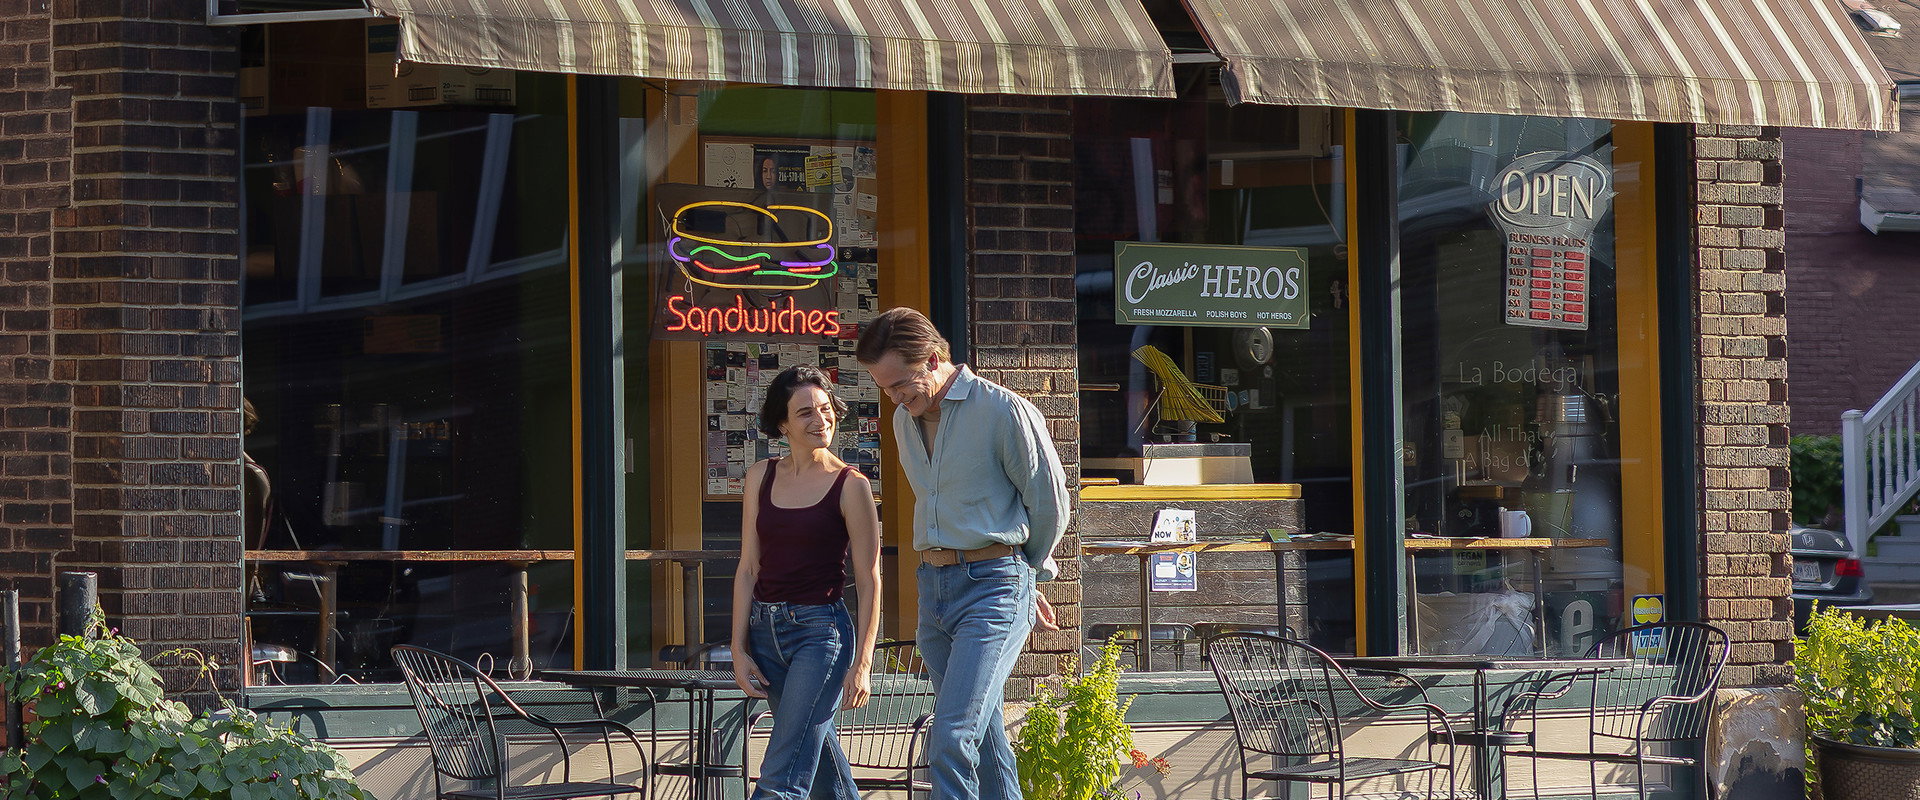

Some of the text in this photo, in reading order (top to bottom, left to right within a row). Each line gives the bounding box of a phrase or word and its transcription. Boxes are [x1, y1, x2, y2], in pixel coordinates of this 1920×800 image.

[1502, 169, 1594, 220] OPEN
[1509, 232, 1587, 248] BUSINESS HOURS
[1509, 246, 1529, 256] MON
[1509, 256, 1525, 266] TUE
[1509, 267, 1529, 276] WED
[1125, 260, 1300, 304] Classic HEROS
[1509, 277, 1527, 287] THU
[1508, 288, 1521, 297] FRI
[666, 294, 842, 337] Sandwiches
[1133, 308, 1293, 320] FRESH MOZZARELLA POLISH BOYS HOT HEROS
[1508, 308, 1526, 318] SUN
[1459, 359, 1578, 392] La Bodega
[1478, 423, 1543, 443] All That
[1483, 451, 1510, 473] Bag
[1154, 531, 1172, 539] NOW
[1456, 551, 1483, 560] VEGAN
